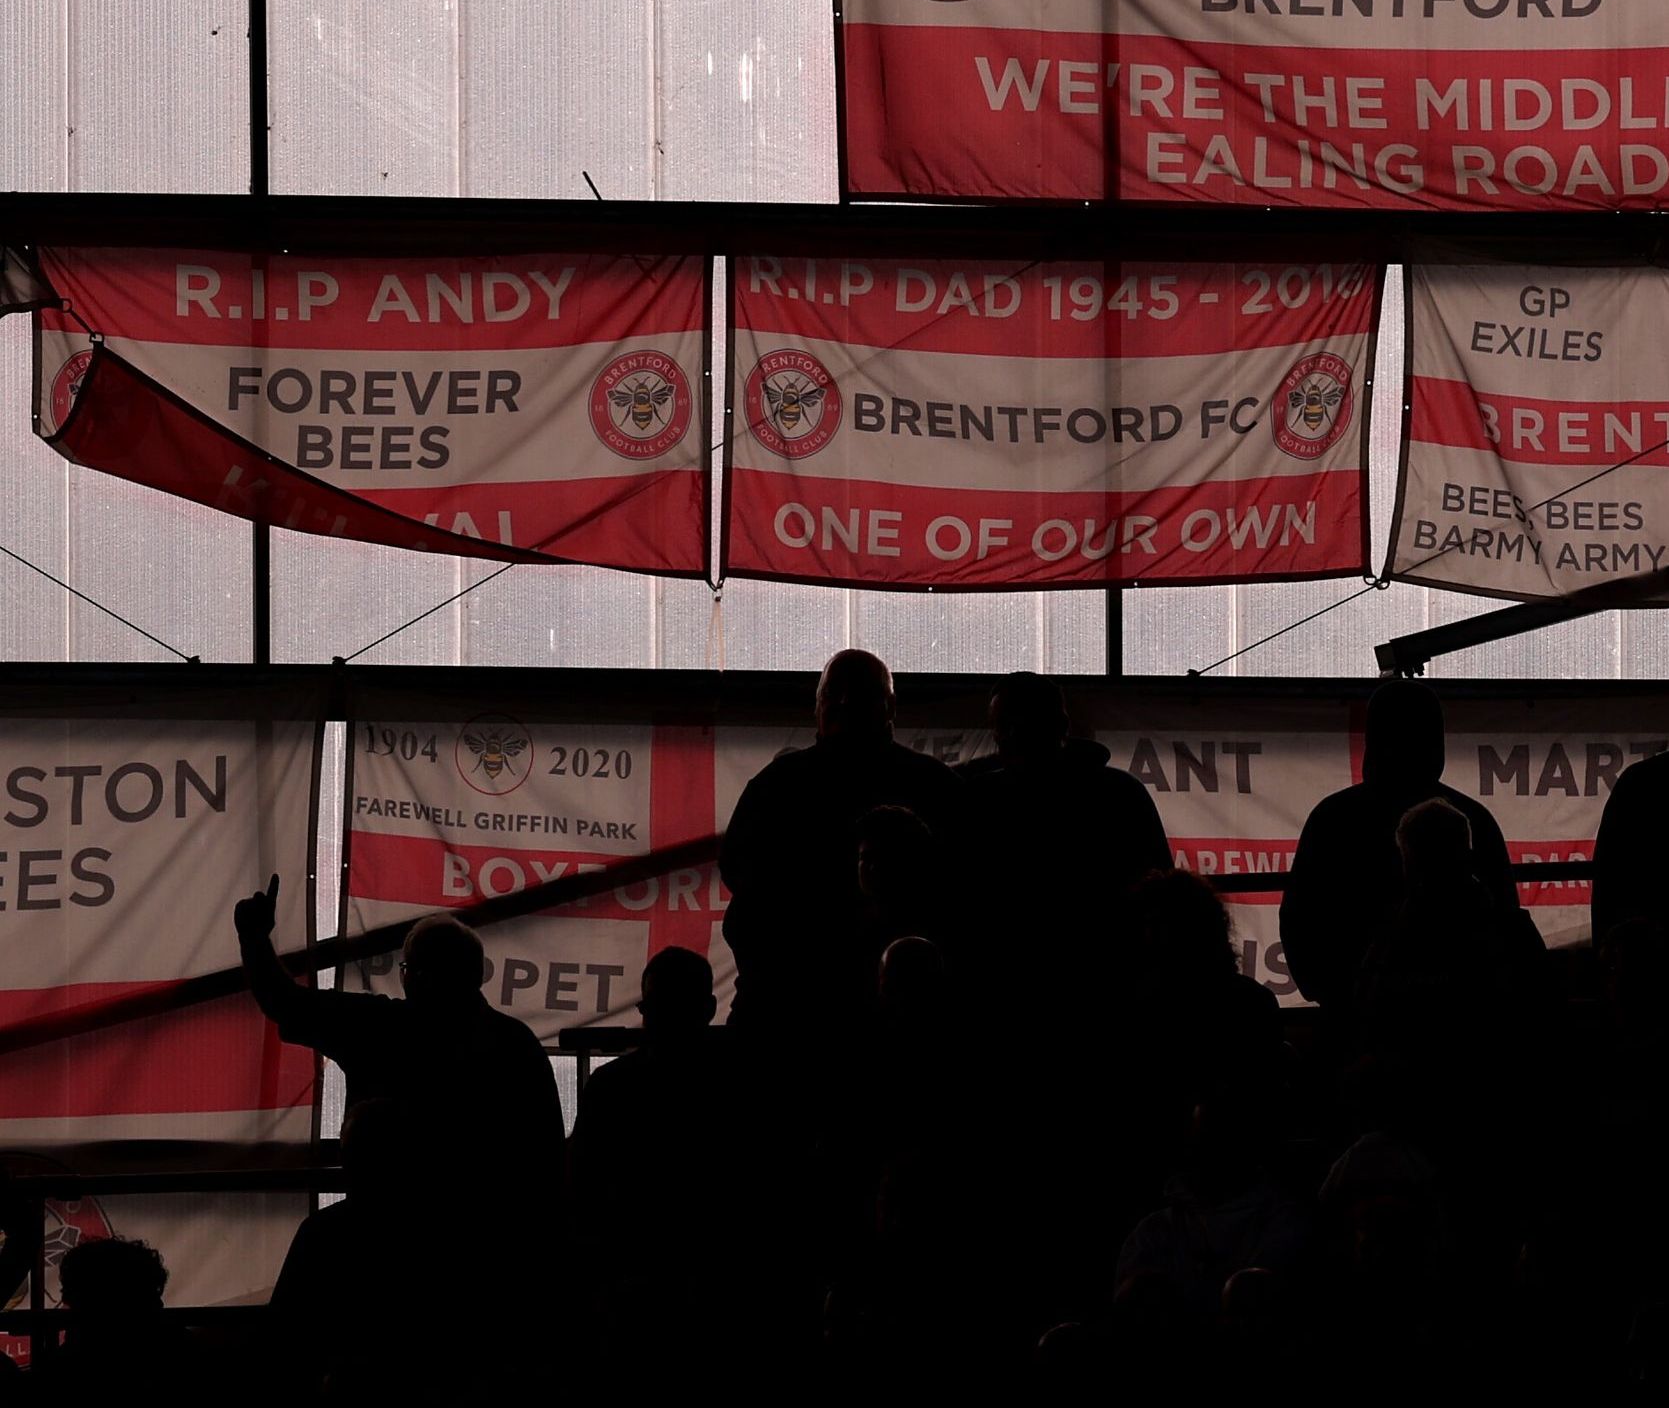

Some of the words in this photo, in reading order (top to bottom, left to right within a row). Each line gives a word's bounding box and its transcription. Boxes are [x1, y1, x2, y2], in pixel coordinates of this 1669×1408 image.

[973, 55, 1225, 123] WE'RE
[1244, 72, 1384, 132] THE
[1146, 133, 1422, 197] EALING
[1453, 142, 1669, 199] ROAD
[174, 264, 340, 320] R.I.P
[367, 267, 577, 325] ANDY
[748, 254, 874, 308] R.I.P
[894, 268, 1022, 318] DAD
[1043, 275, 1180, 321] 1945
[1519, 285, 1570, 318] GP
[1471, 320, 1603, 362] EXILES
[228, 366, 522, 417] FOREVER
[604, 355, 677, 385] BRENTFORD
[761, 355, 829, 384] RENTFORD
[606, 430, 656, 454] FOOTBALL
[657, 425, 681, 448] CLUB
[854, 393, 1183, 444] BRENTFORD
[1200, 396, 1258, 439] FC
[296, 425, 450, 470] BEES
[773, 502, 902, 557] ONE
[925, 515, 1013, 561] OF
[1030, 516, 1158, 561] OUR
[1180, 501, 1317, 554] OWN
[1546, 500, 1644, 531] BEES
[1413, 519, 1544, 566] BARMY
[1555, 542, 1666, 572] ARMY
[364, 724, 438, 763] 1904
[549, 745, 632, 779] 2020
[355, 796, 467, 829] FAREWELL
[474, 811, 568, 835] GRIFFIN
[576, 819, 637, 840] PARK
